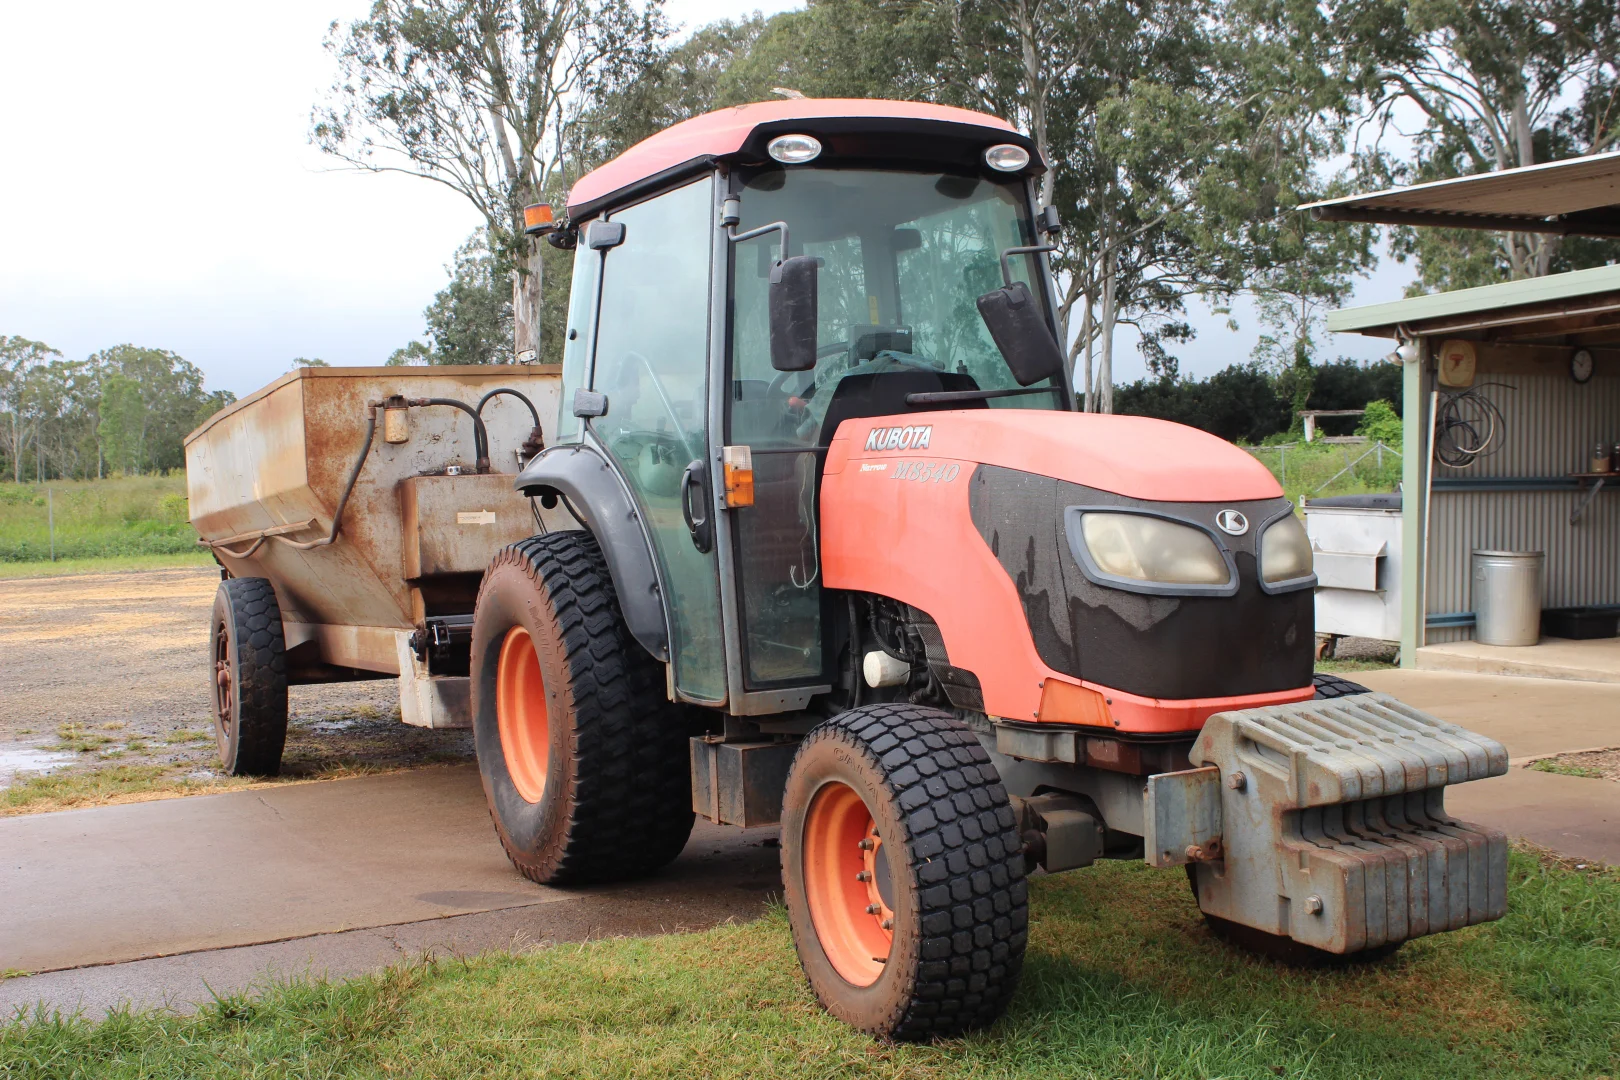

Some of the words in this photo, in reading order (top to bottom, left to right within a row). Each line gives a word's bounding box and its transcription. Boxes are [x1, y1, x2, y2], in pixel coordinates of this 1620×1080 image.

[865, 425, 933, 451] KUBOTA
[860, 464, 888, 472] Narrow
[890, 461, 961, 483] M8540
